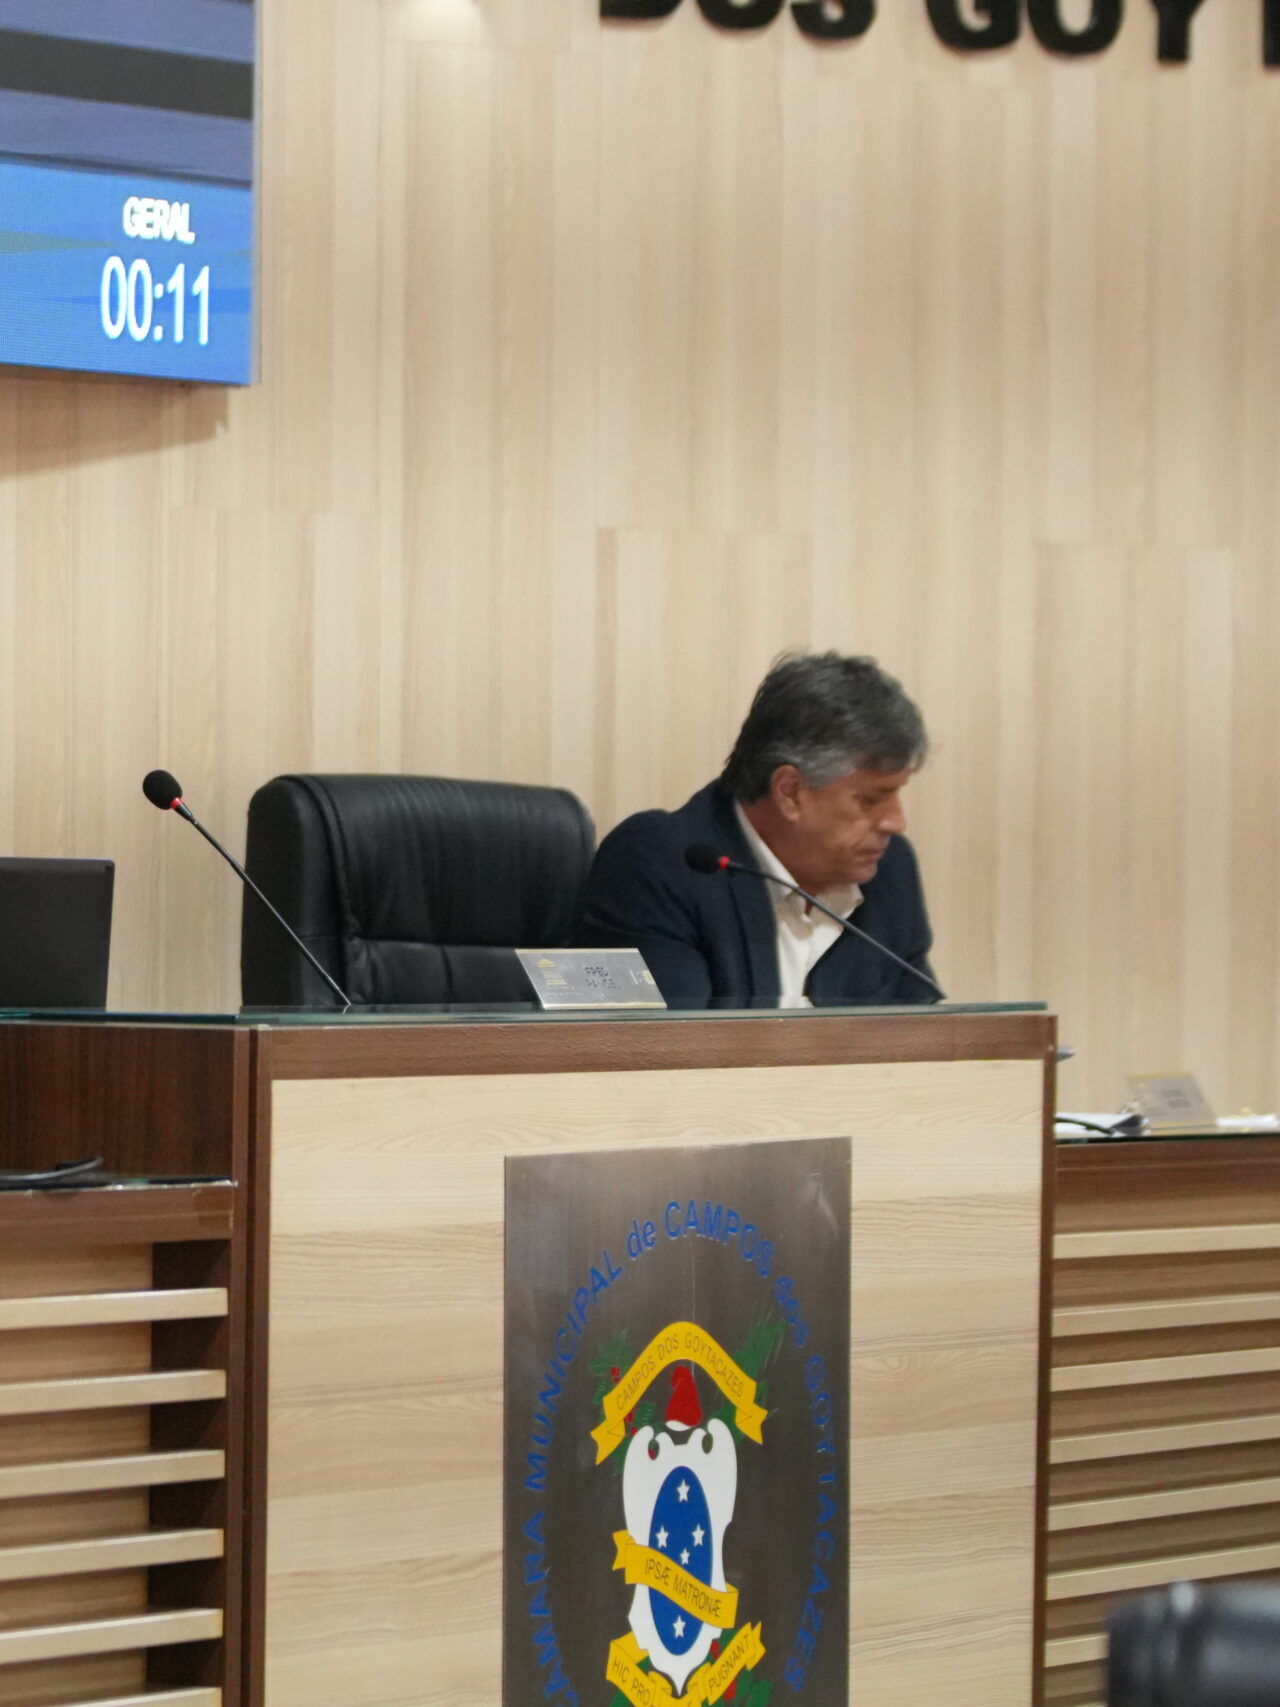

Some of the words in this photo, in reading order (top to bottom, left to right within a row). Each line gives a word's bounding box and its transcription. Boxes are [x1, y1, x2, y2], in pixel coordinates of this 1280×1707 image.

[926, 0, 1280, 63] GOY
[122, 195, 196, 244] GERAL
[100, 255, 211, 345] 00:11
[524, 1250, 624, 1492] MUNICIPAL
[626, 1220, 657, 1260] de
[664, 1200, 775, 1279] CAMPOS
[616, 1355, 656, 1410] CAMPOS
[657, 1333, 680, 1361] DOS
[684, 1331, 745, 1398] GOYTACAZES
[612, 1656, 630, 1684] HIC
[631, 1678, 651, 1706] PRO
[708, 1634, 750, 1691] PUGNANT
